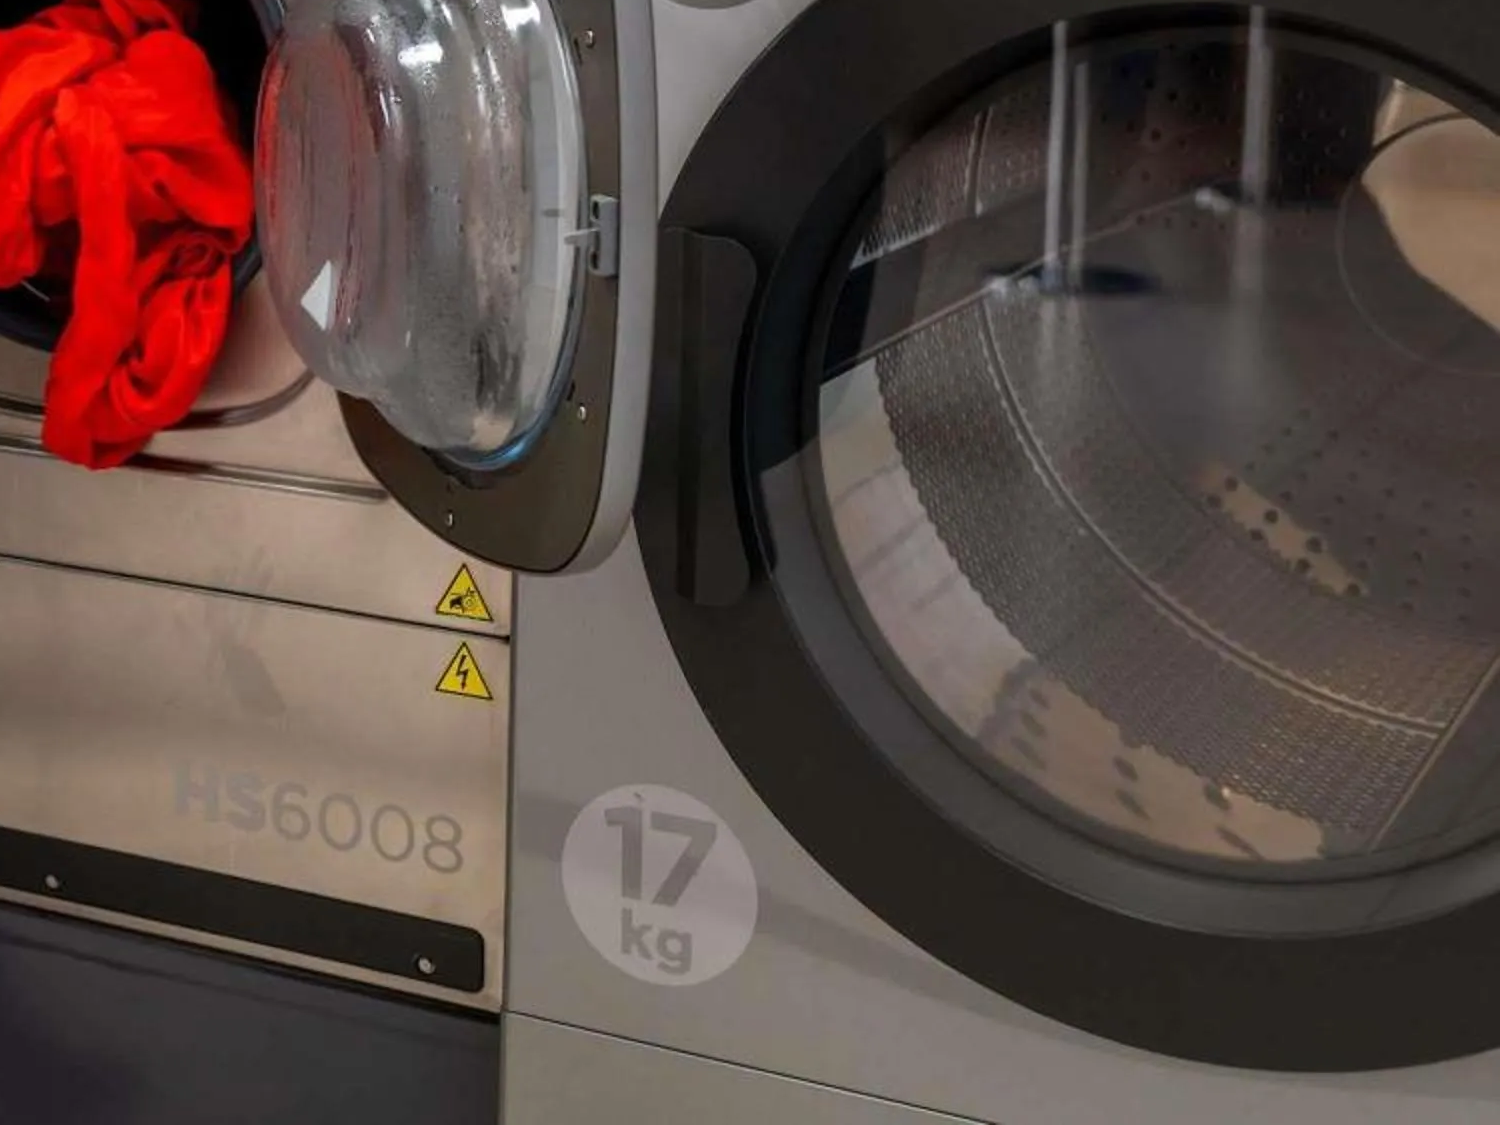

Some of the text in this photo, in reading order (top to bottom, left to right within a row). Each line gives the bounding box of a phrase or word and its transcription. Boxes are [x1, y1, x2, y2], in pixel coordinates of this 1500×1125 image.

[174, 758, 464, 874] HS6008
[603, 805, 718, 908] 17
[618, 908, 693, 975] kg
